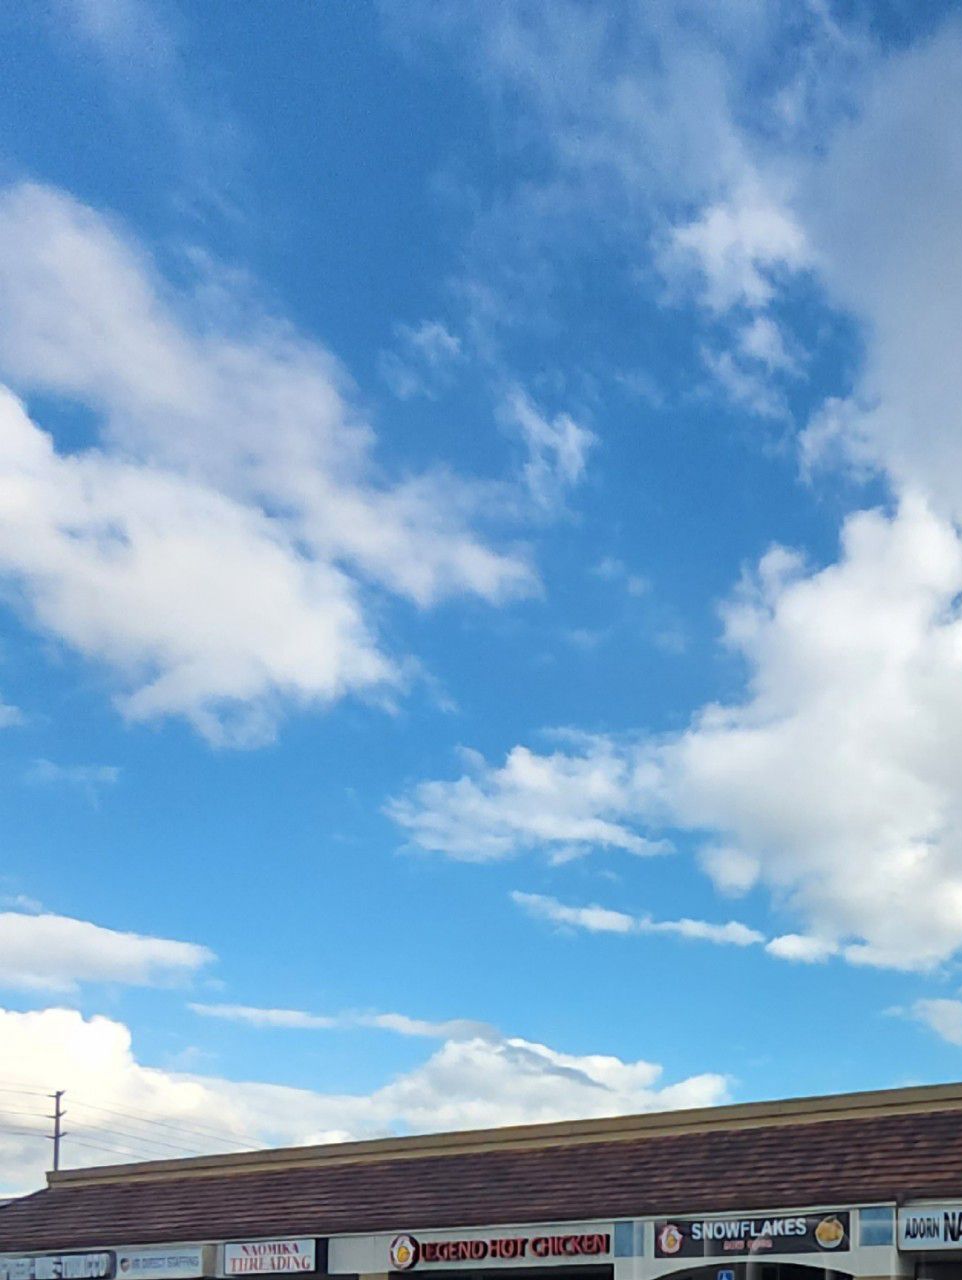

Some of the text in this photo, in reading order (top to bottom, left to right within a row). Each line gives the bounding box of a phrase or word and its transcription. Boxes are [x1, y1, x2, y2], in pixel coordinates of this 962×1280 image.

[691, 1218, 807, 1240] SNOWFLAKES
[905, 1217, 940, 1240] ADORN
[242, 1242, 300, 1256] NAOMIKA
[419, 1233, 611, 1262] LEGEND HOT CHICKEN
[231, 1255, 311, 1272] THREADING
